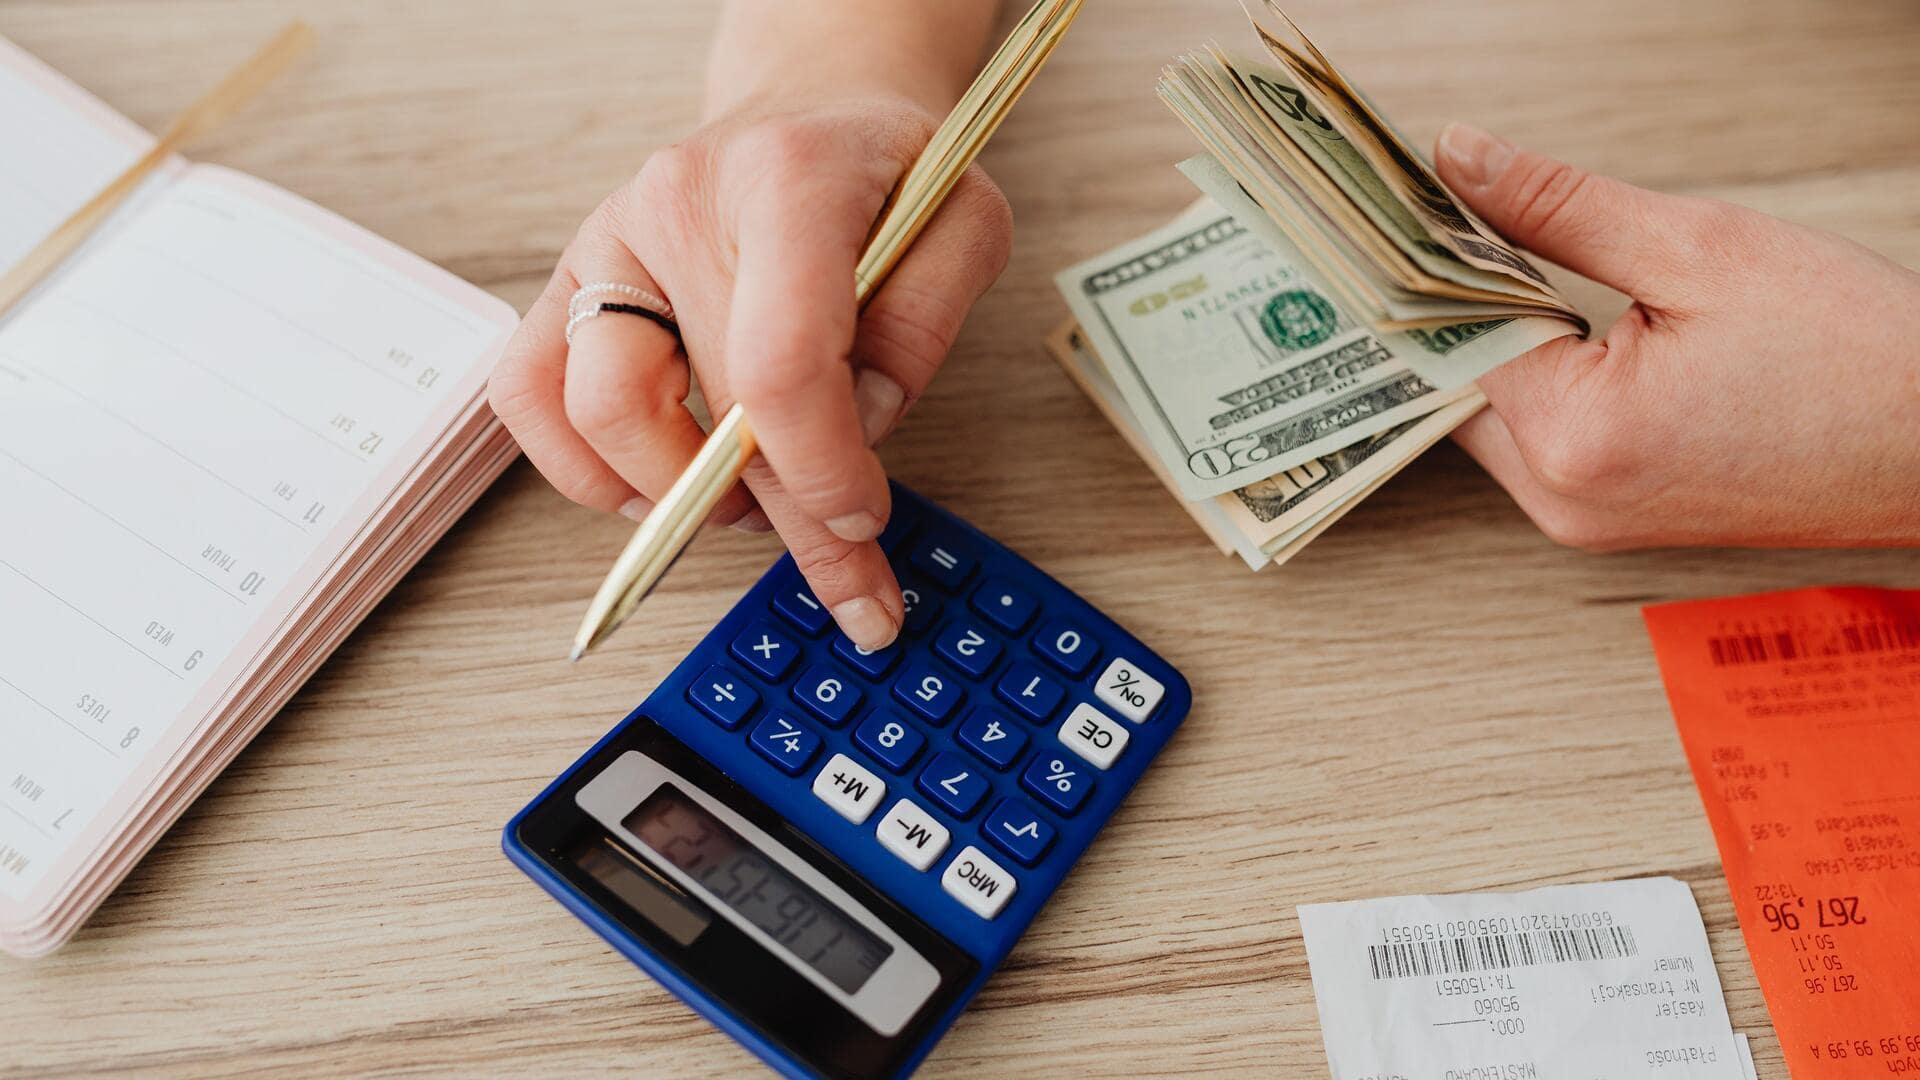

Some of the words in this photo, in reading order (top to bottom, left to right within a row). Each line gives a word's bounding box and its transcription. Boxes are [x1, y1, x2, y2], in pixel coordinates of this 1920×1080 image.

[418, 368, 439, 389] 13
[330, 414, 356, 433] SAT
[360, 432, 383, 454] 12
[1187, 432, 1269, 481] 20
[273, 481, 297, 500] FRI
[303, 502, 325, 523] 11
[202, 544, 237, 572] THUR
[239, 571, 266, 596] 10
[144, 621, 174, 647] WED
[956, 629, 986, 656] 2
[1056, 630, 1081, 654] 0
[184, 650, 204, 671] 9
[815, 678, 842, 703] 9
[920, 676, 944, 701] 5
[1021, 676, 1041, 697] 1
[1117, 669, 1146, 708] ON/C
[76, 694, 111, 724] TUES
[120, 727, 140, 748] 8
[878, 722, 905, 748] 8
[986, 720, 1008, 745] 4
[1077, 718, 1113, 749] CE
[11, 774, 46, 802] MON
[832, 772, 869, 802] M+
[940, 771, 969, 796] 7
[53, 809, 73, 829] 7
[957, 860, 1000, 898] MRC
[1755, 883, 1797, 900] 13:22
[1762, 896, 1867, 932] 267,96
[1791, 933, 1836, 952] 50,11
[1654, 957, 1695, 973] Numer
[1798, 954, 1843, 973] 50,11
[1435, 973, 1515, 996] TA:150551
[1590, 979, 1674, 1002] transakcji
[1680, 978, 1699, 995] Nr
[1804, 975, 1859, 995] 267,96
[1474, 996, 1519, 1015] 95060
[1656, 998, 1705, 1018] Kasjer
[1809, 1045, 1819, 1060] A
[1828, 1040, 1873, 1060] 99,99
